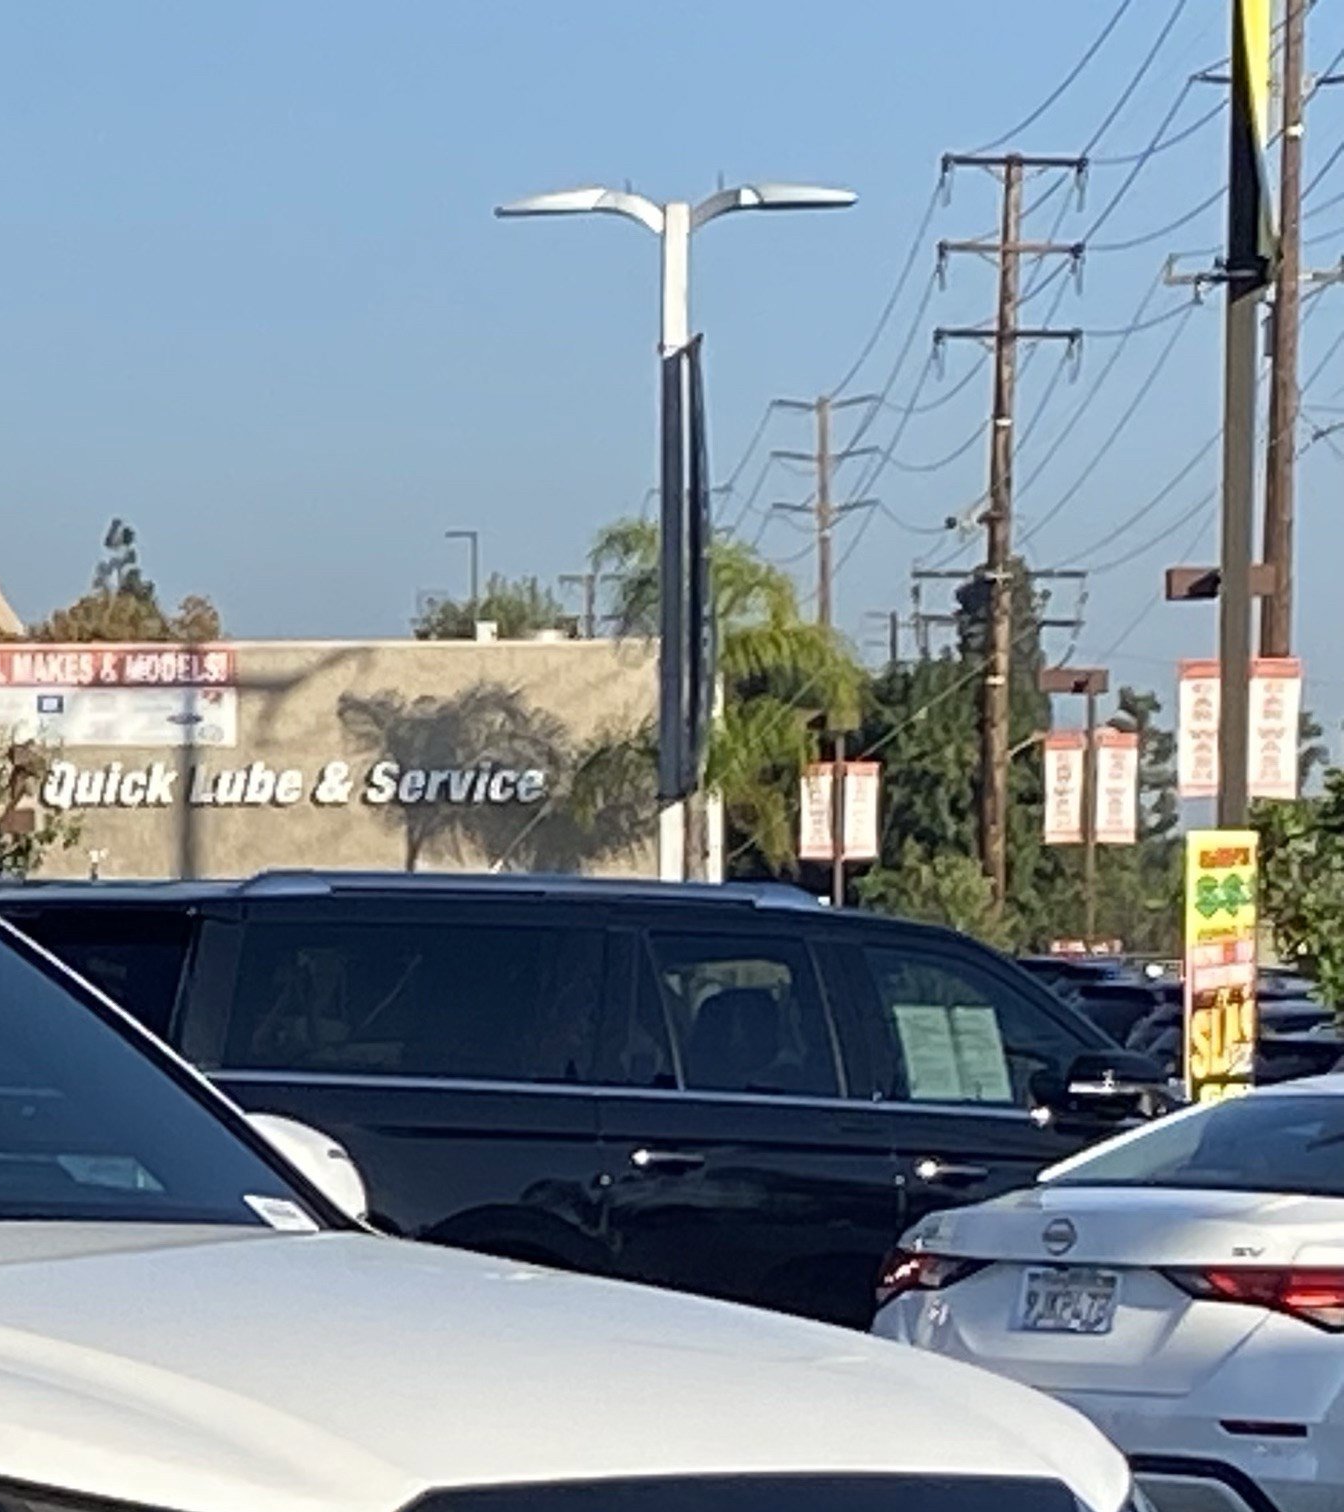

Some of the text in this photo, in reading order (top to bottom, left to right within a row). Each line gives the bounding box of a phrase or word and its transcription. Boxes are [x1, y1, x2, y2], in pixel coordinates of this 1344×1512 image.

[12, 652, 96, 685] MAKES
[99, 653, 119, 683] &
[43, 758, 547, 807] Quick Lube & Service
